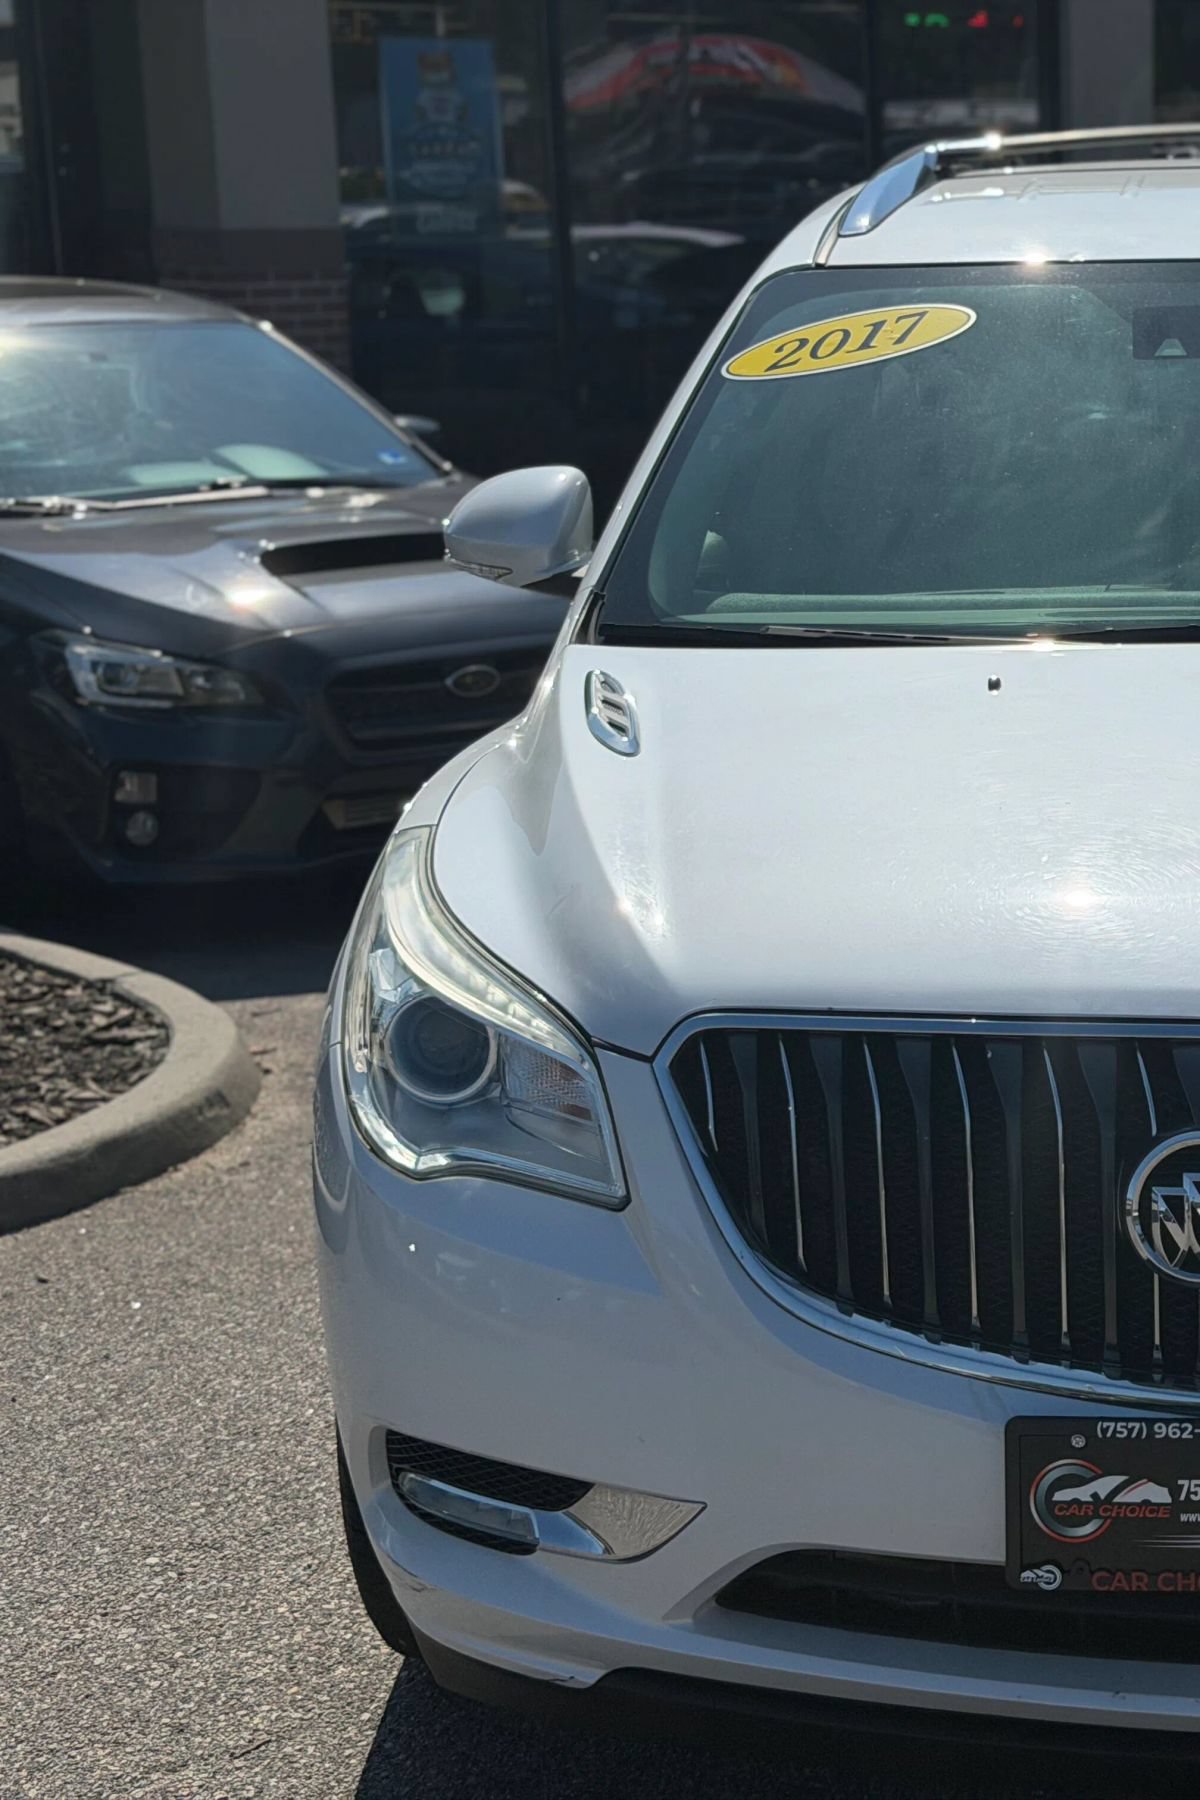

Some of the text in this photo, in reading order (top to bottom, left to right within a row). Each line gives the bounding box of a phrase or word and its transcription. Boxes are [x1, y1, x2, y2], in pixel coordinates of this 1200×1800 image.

[764, 310, 929, 373] 2017
[1096, 1421, 1147, 1439] (757)
[1054, 1503, 1172, 1518] CAR CHOICE
[1091, 1571, 1149, 1592] CAR
